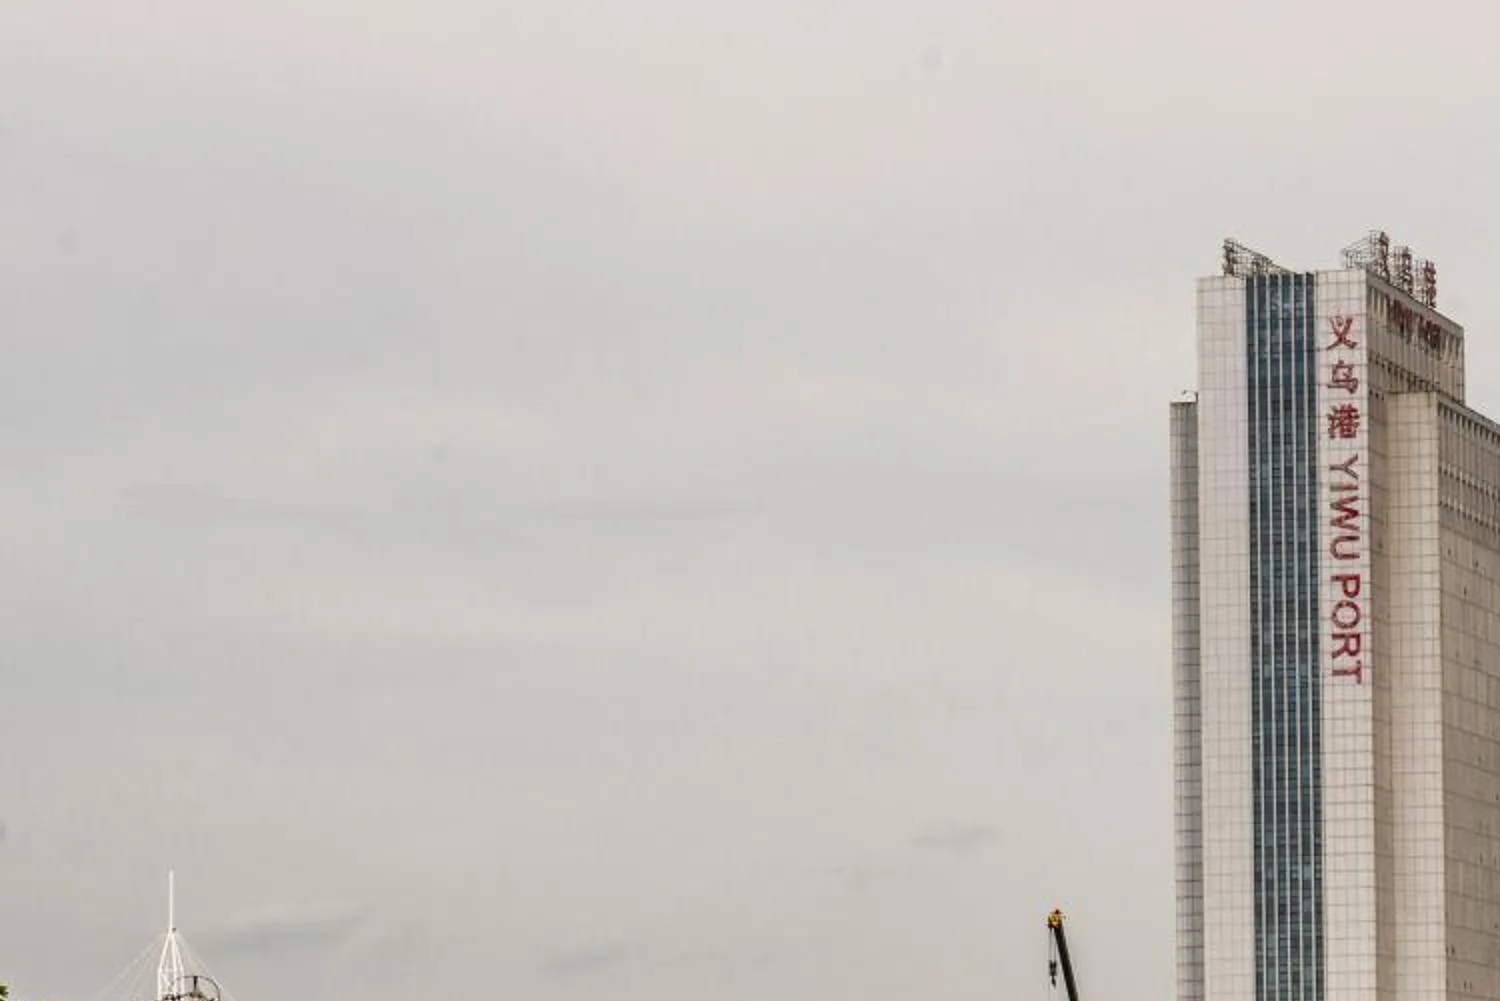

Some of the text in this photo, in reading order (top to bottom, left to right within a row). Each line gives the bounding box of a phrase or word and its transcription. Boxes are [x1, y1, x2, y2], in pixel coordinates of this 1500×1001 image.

[1326, 315, 1359, 439] 义乌港
[1329, 455, 1362, 683] YIWU PORT
